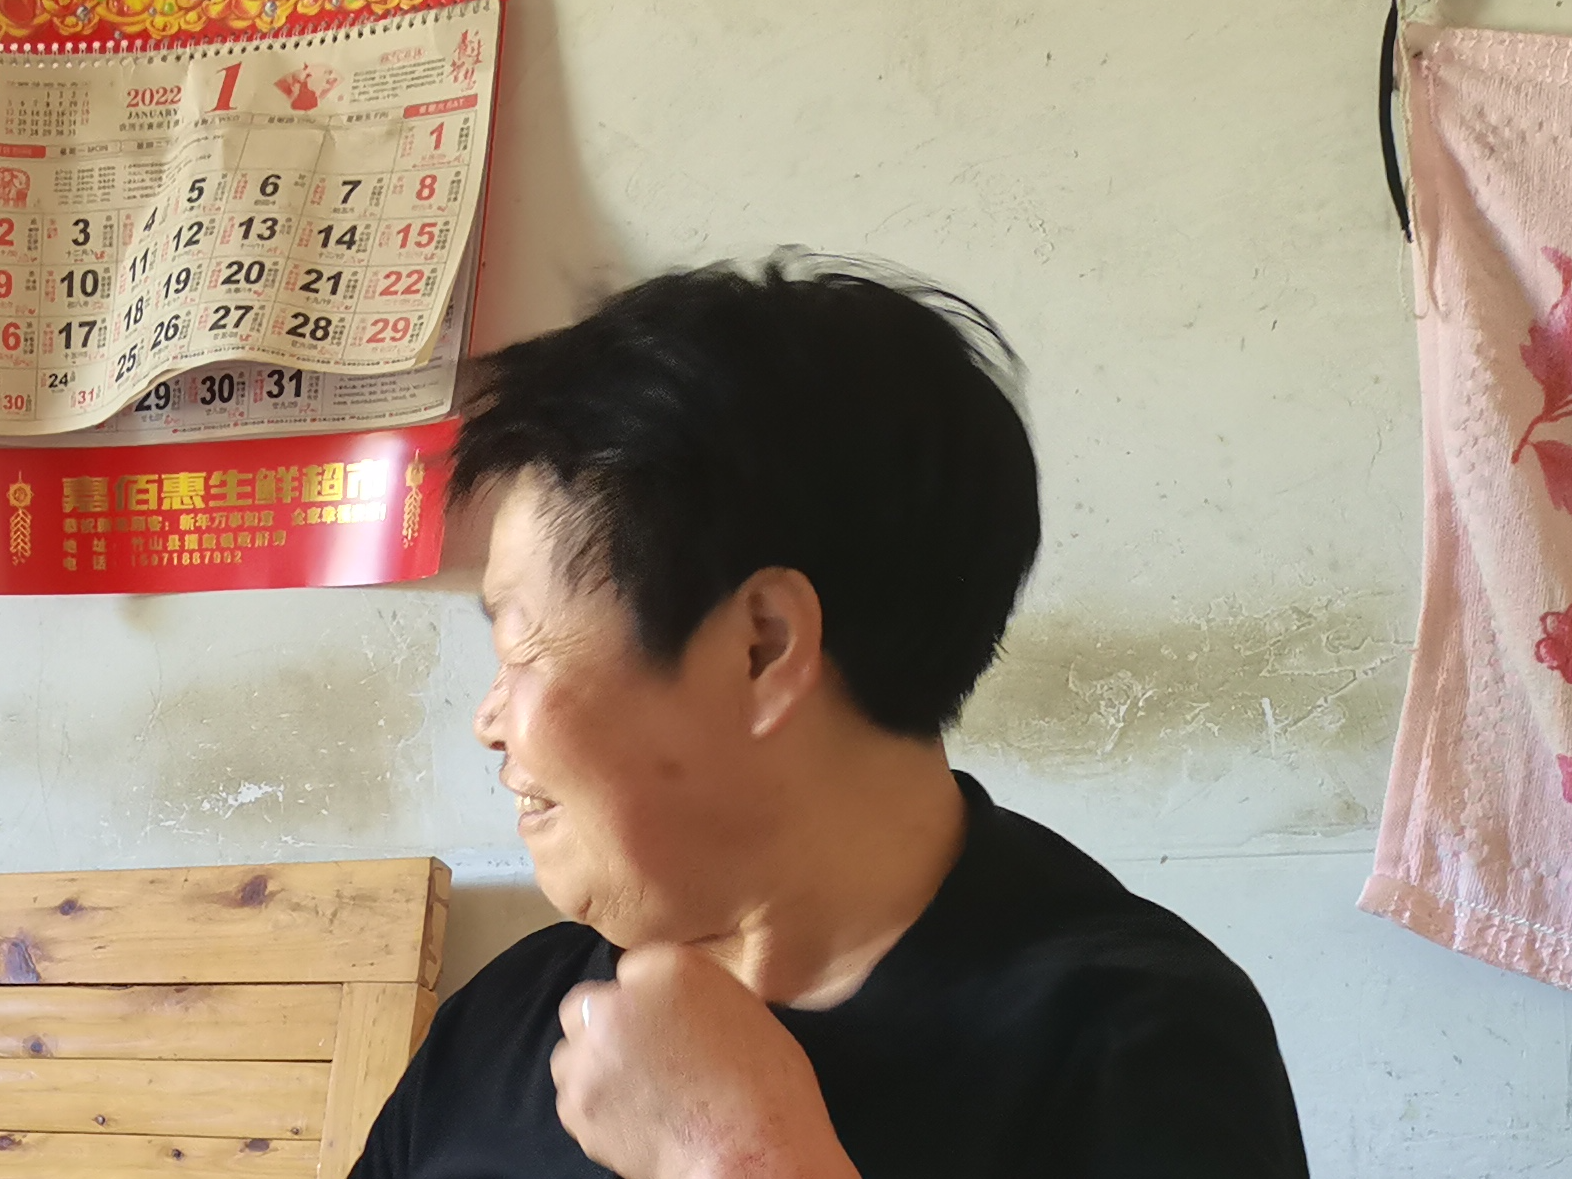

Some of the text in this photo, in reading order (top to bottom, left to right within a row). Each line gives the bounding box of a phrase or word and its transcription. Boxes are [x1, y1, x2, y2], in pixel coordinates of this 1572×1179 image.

[126, 86, 182, 108] 2022
[204, 60, 244, 114] 1
[127, 108, 180, 120] JANUARY
[429, 122, 445, 150] 1
[187, 177, 208, 203] 5
[259, 174, 282, 197] 6
[340, 180, 363, 205] 7
[415, 174, 438, 201] 8
[72, 218, 91, 246] 3
[143, 207, 159, 232] 4
[237, 216, 279, 241] 13
[172, 220, 204, 251] 12
[316, 224, 358, 250] 14
[395, 222, 438, 249] 15
[129, 248, 150, 283] 11
[221, 260, 266, 286] 20
[60, 269, 99, 298] 10
[163, 267, 192, 299] 19
[299, 268, 343, 296] 21
[379, 269, 425, 297] 22
[124, 296, 144, 332] 18
[208, 305, 254, 332] 27
[285, 311, 332, 341] 28
[58, 320, 98, 350] 17
[150, 314, 182, 351] 26
[365, 316, 411, 343] 29
[115, 343, 139, 383] 25
[48, 372, 69, 389] 24
[199, 372, 235, 405] 30
[266, 368, 304, 400] 31
[2, 394, 25, 411] 30
[77, 388, 95, 405] 31
[134, 382, 171, 412] 29
[62, 458, 388, 513] 嘉佰惠生鲜超市
